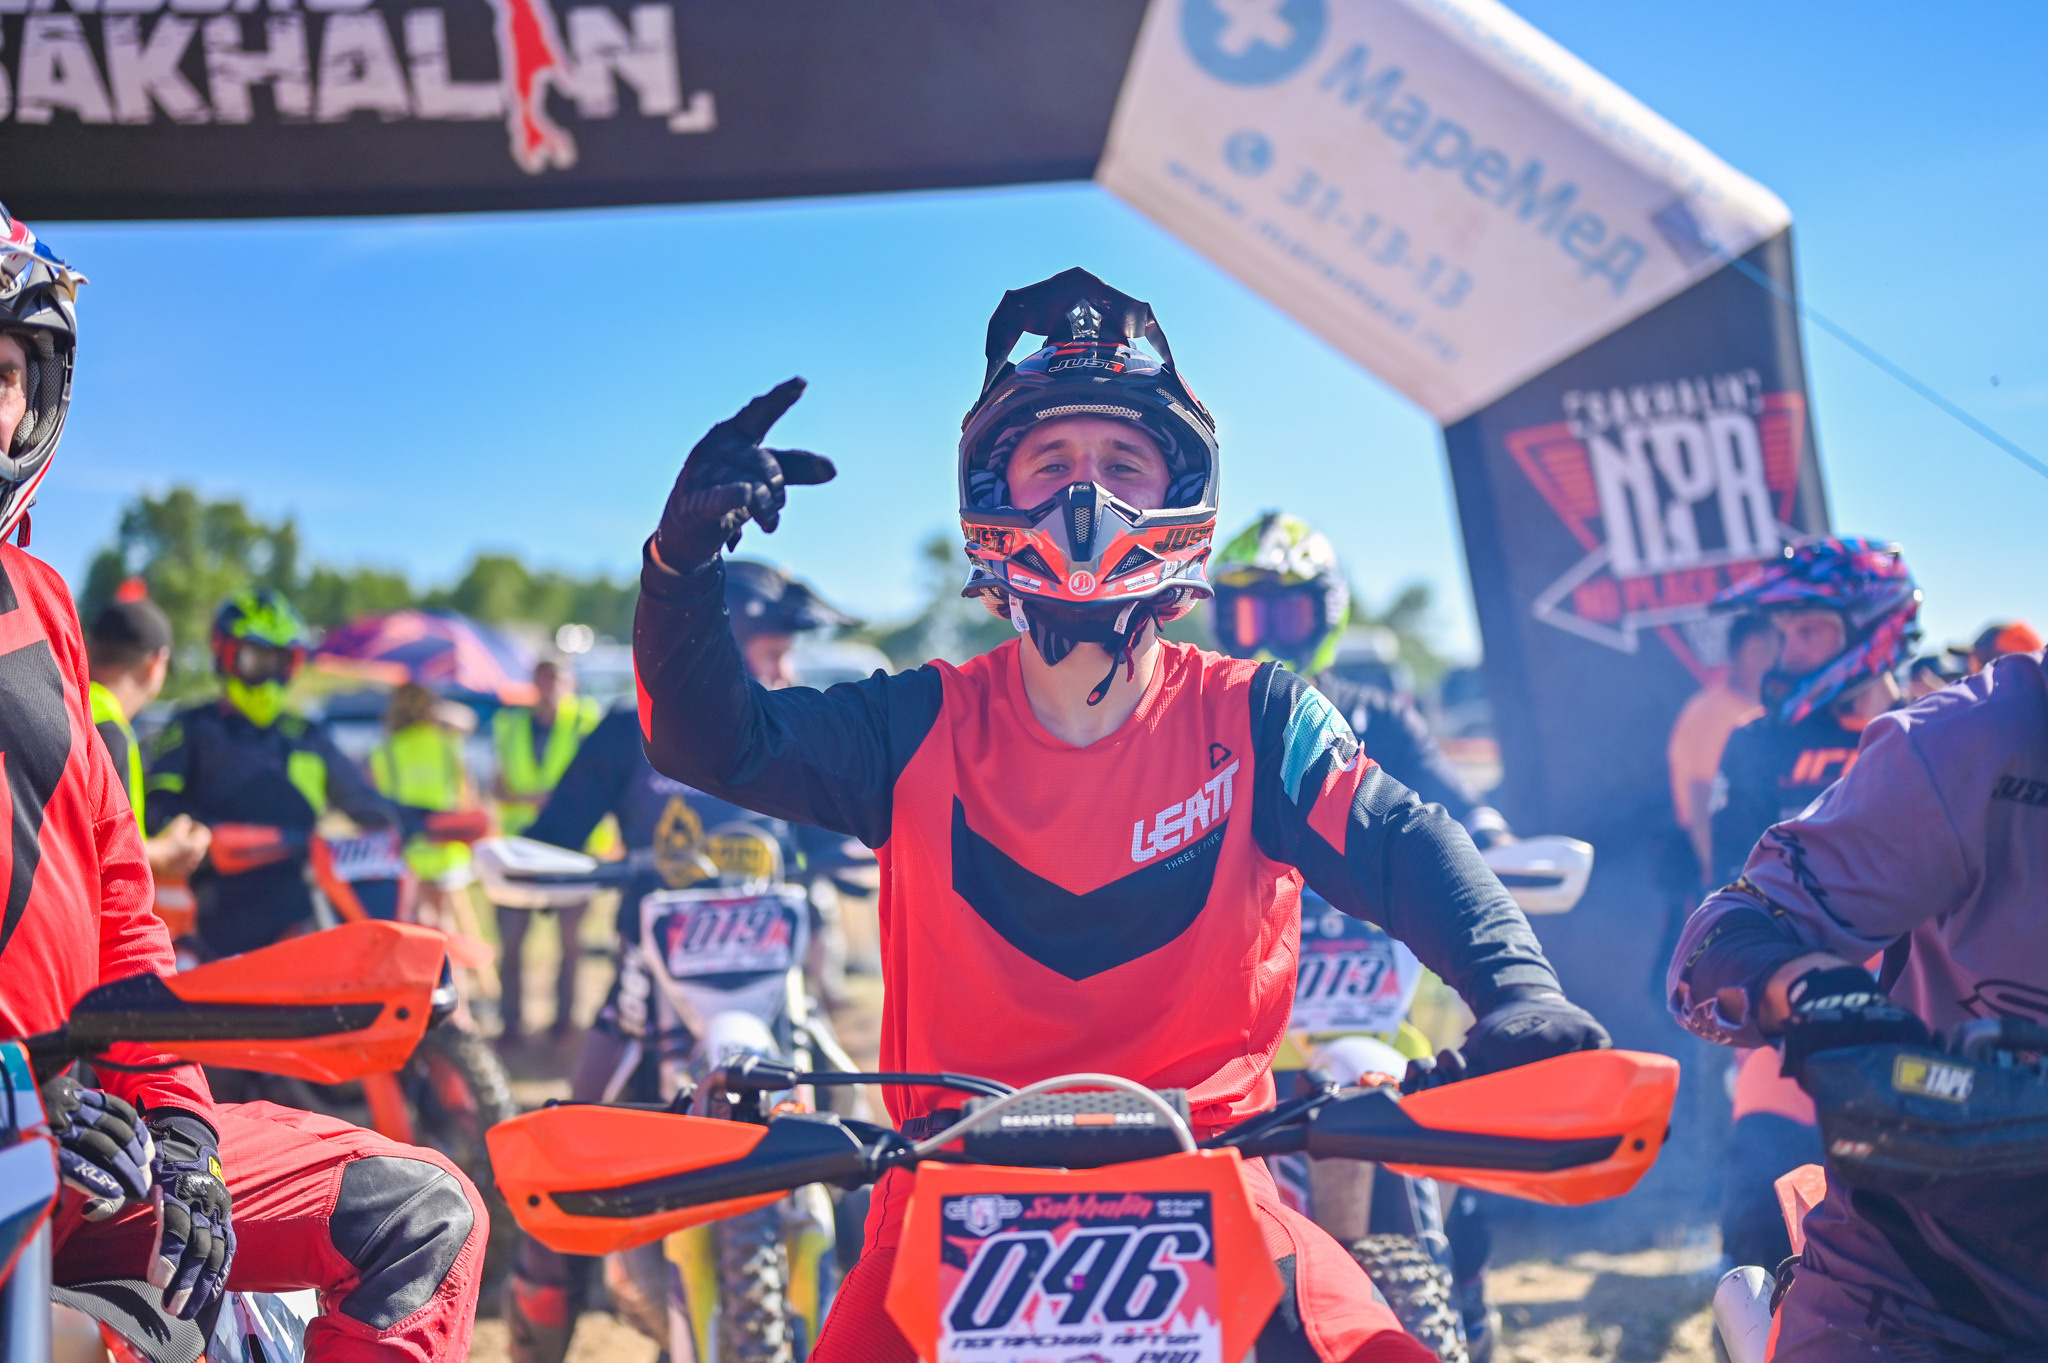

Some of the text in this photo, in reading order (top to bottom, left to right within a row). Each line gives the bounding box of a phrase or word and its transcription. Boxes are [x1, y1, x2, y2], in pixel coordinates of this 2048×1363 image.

[1318, 42, 1649, 297] МареМед
[1279, 166, 1475, 311] 31-13-13
[1131, 758, 1240, 863] LEATT
[1164, 850, 1196, 871] THREE
[1203, 833, 1221, 850] FIVE
[1001, 1113, 1156, 1127] READY TO RACE
[74, 1162, 120, 1190] KLIM
[945, 1226, 1207, 1333] 096
